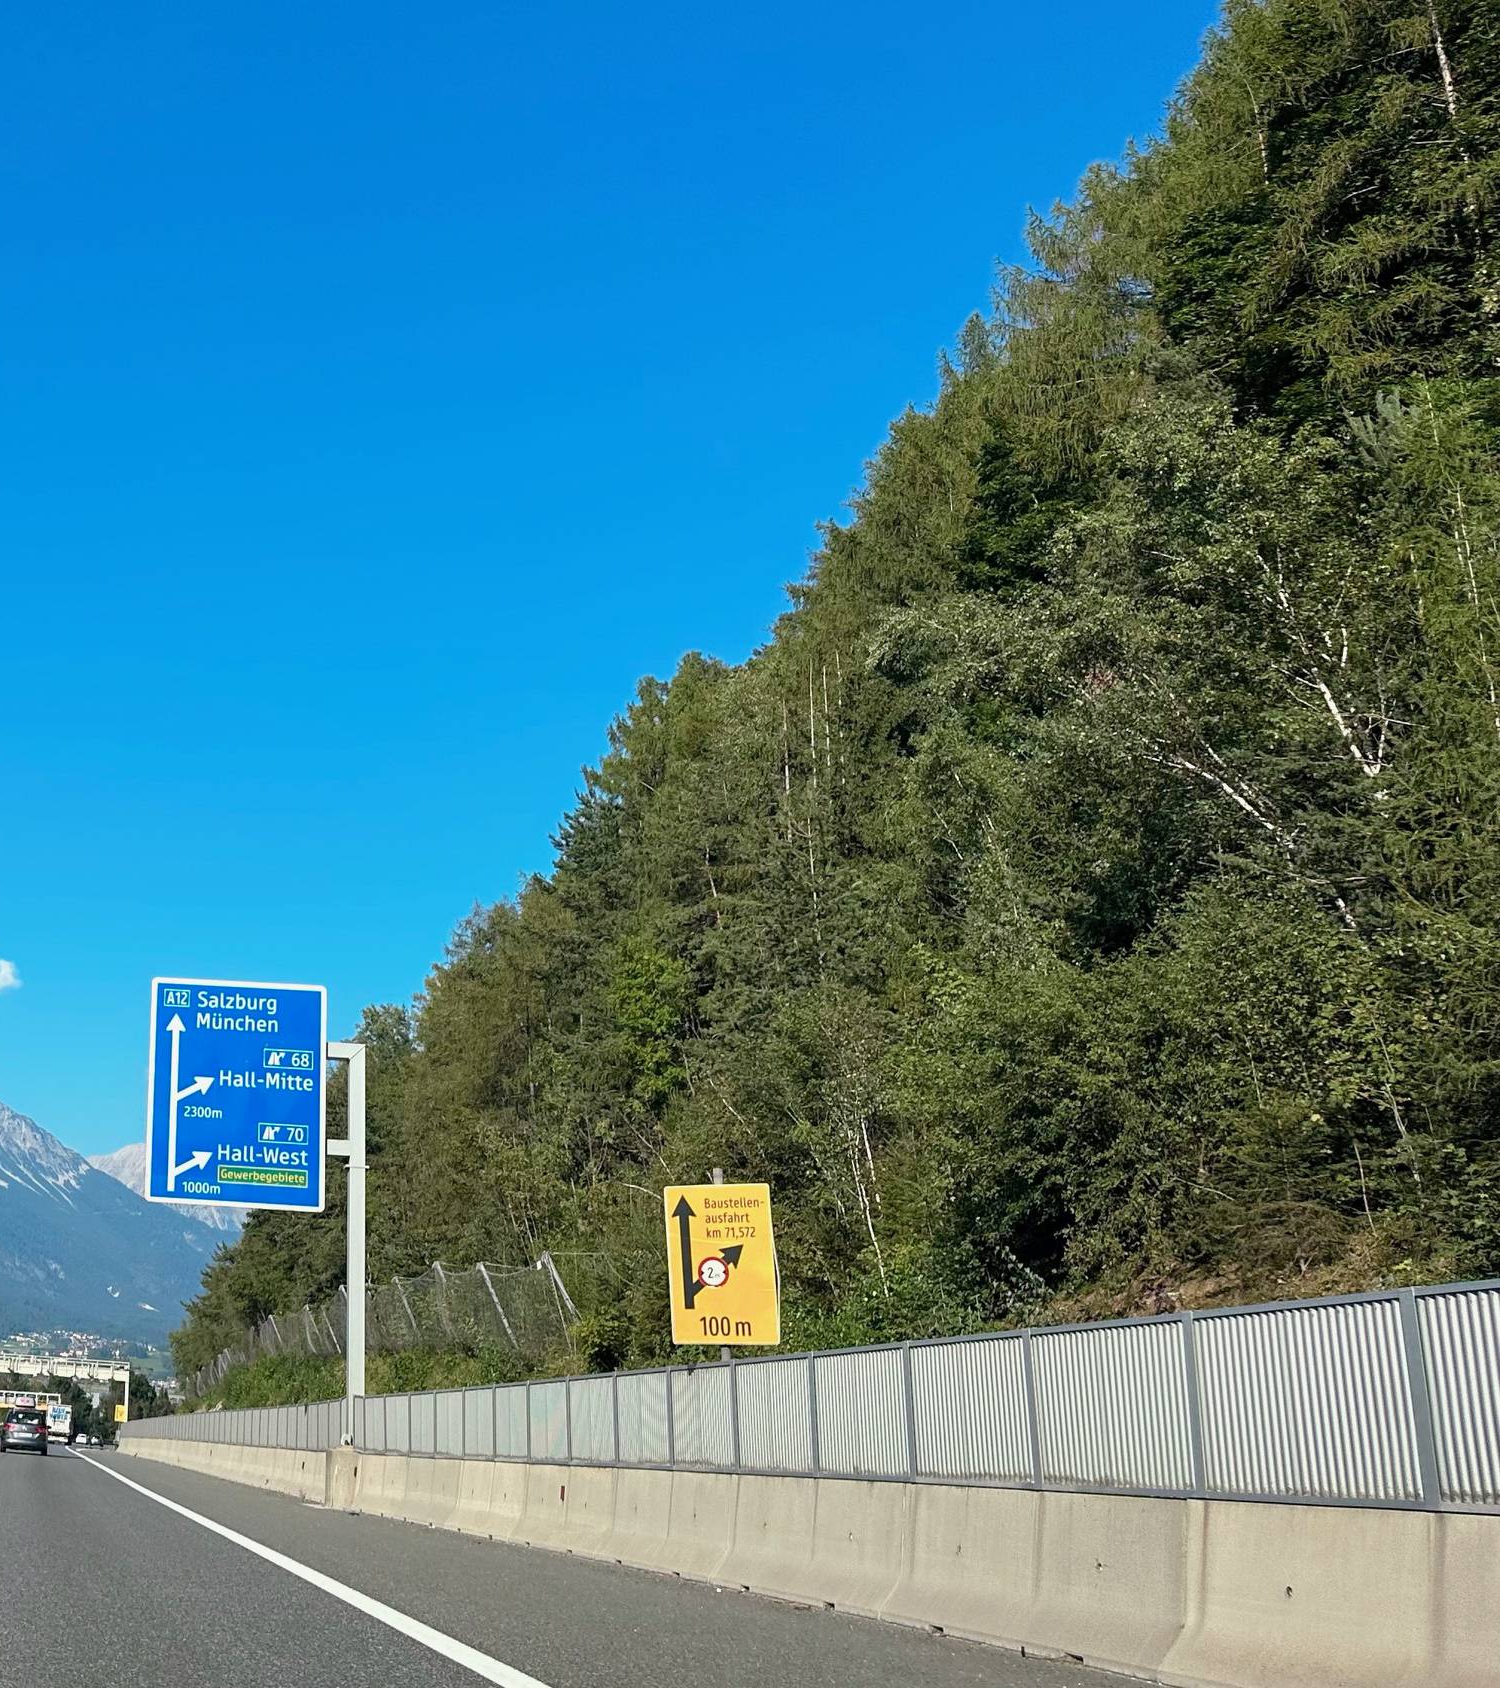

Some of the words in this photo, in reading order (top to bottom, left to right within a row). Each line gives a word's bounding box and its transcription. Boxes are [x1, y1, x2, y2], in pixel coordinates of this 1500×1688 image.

[166, 992, 188, 1005] A12
[197, 991, 277, 1014] Salzburg
[196, 1012, 279, 1033] München
[291, 1052, 310, 1068] 68
[219, 1070, 314, 1091] Hall-Mitte
[183, 1106, 223, 1119] 2300m
[287, 1127, 304, 1142] 70
[217, 1144, 309, 1166] Hall-West
[220, 1168, 305, 1184] Gewerbegebiete
[182, 1181, 221, 1195] 1000m
[704, 1197, 764, 1209] Baustellen-
[705, 1212, 750, 1224] ausfahrt
[706, 1227, 722, 1238] km
[725, 1226, 756, 1240] 71,572
[700, 1316, 731, 1337] 100
[735, 1320, 752, 1337] m
